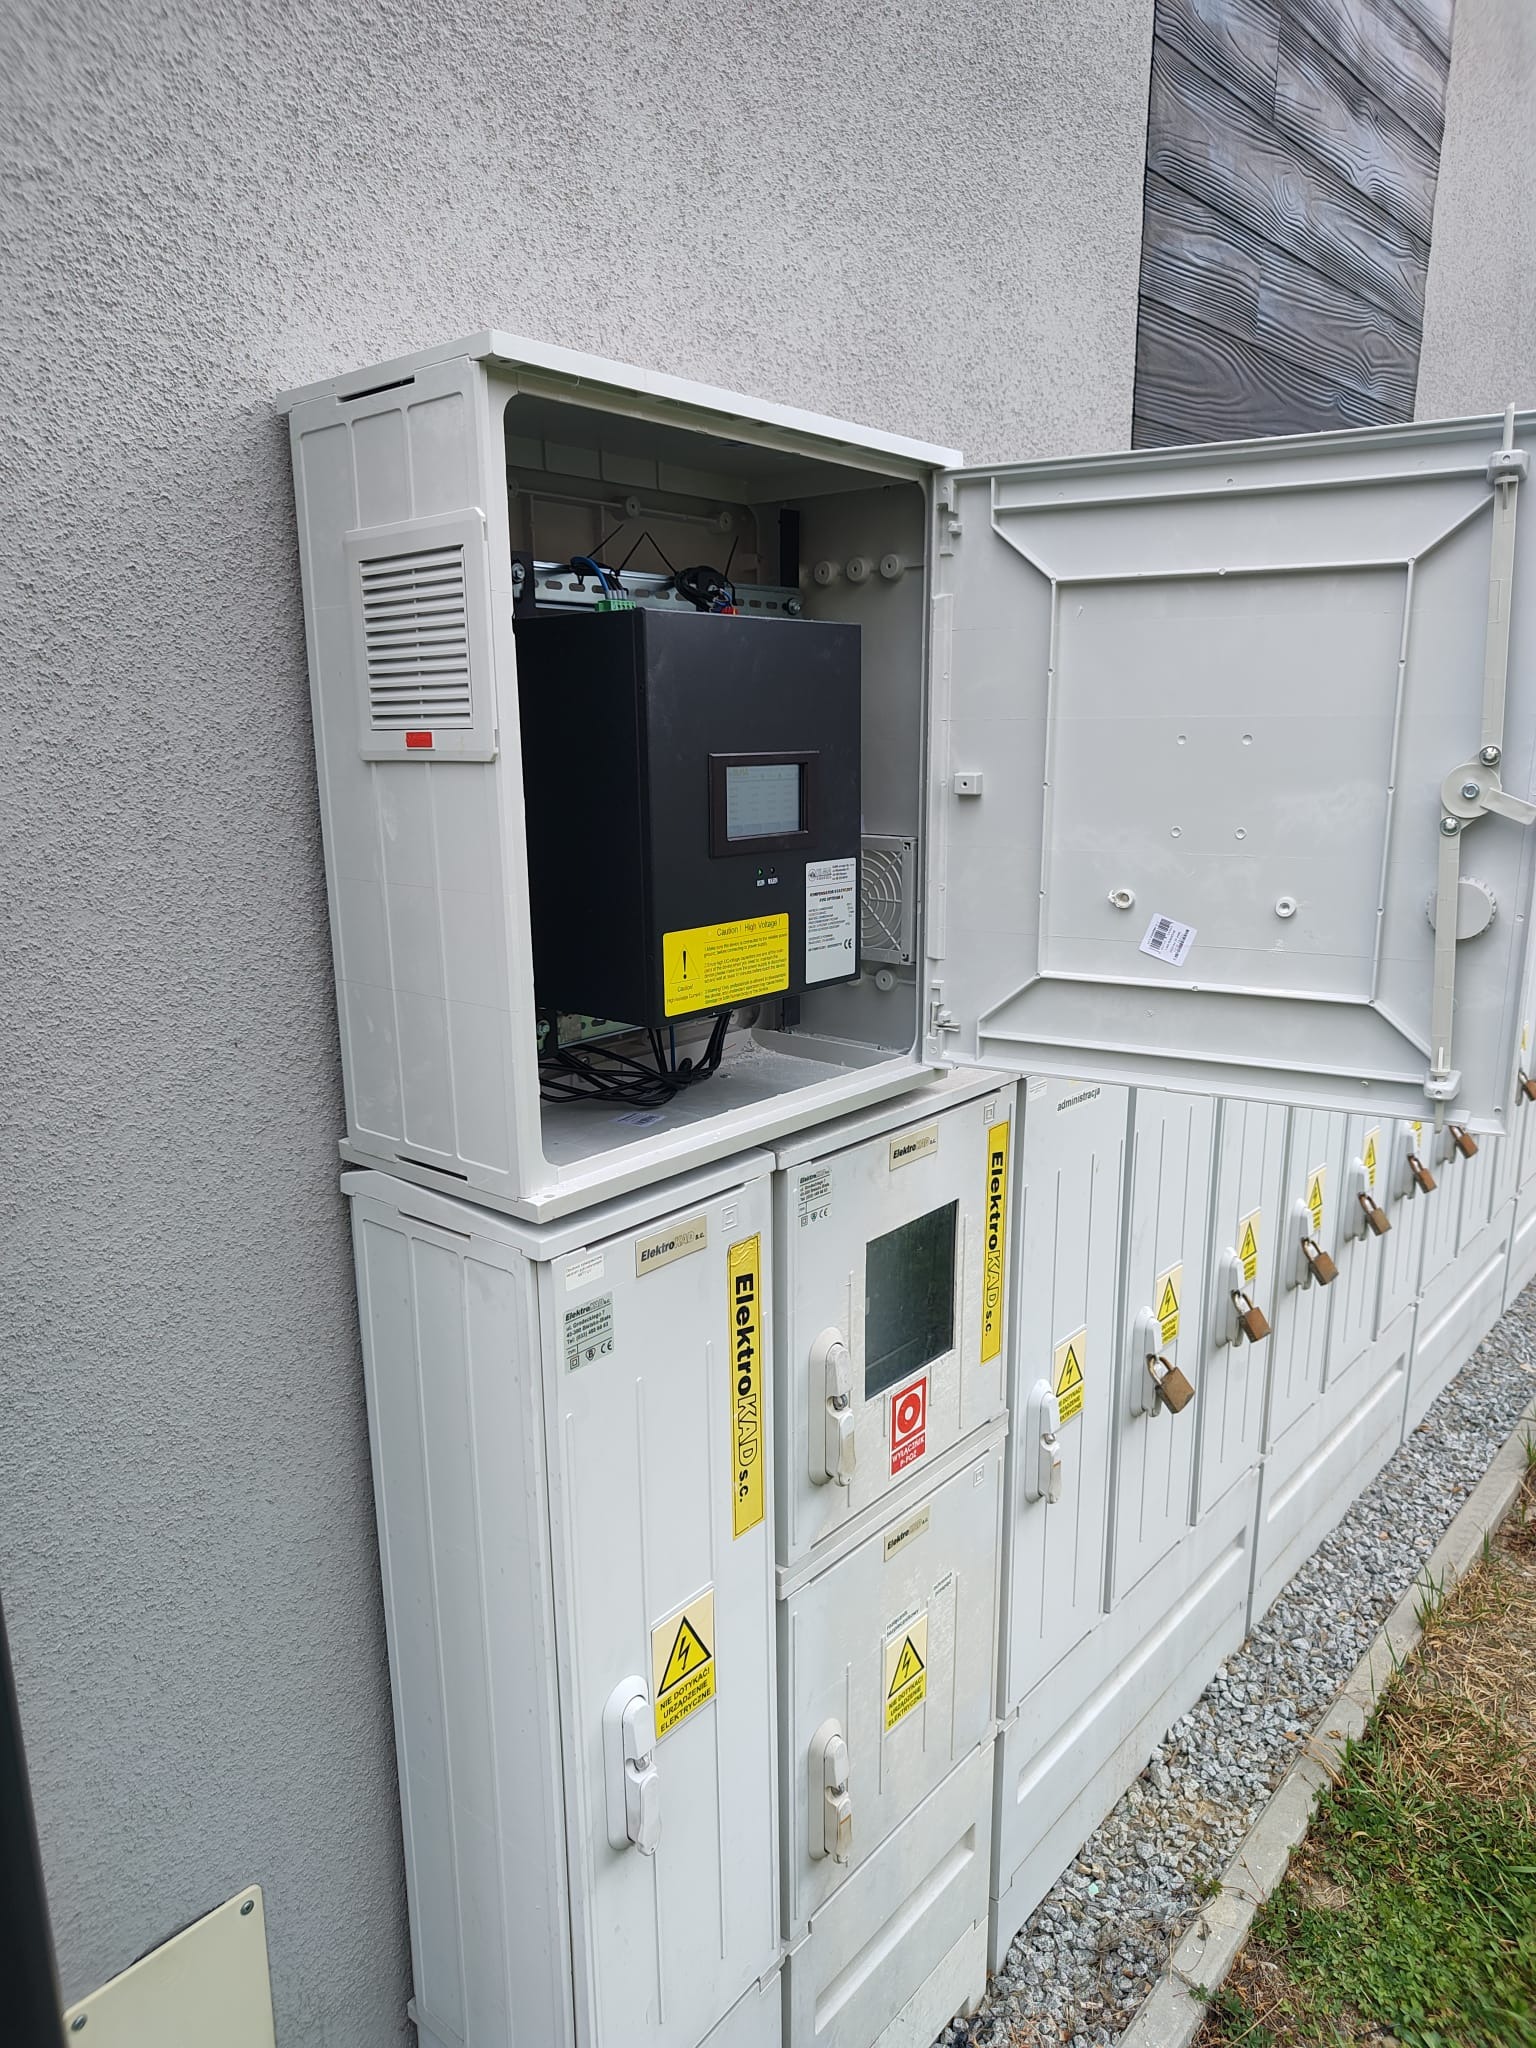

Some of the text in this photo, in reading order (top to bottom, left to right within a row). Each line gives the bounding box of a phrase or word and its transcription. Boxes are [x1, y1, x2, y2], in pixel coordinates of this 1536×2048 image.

[716, 926, 738, 936] Caution
[744, 923, 756, 932] High
[758, 920, 777, 929] Voltage
[1056, 1087, 1101, 1112] administracja
[640, 1230, 696, 1263] ElektroKAD
[985, 1151, 1004, 1308] ElektroKAD
[735, 1272, 758, 1504] ElektroKAD s.c.
[660, 1666, 710, 1712] NIE DOTYKAĆ!
[664, 1679, 708, 1718] URZĄDZENIE
[888, 1691, 924, 1726] ELEKTRYCZNE
[660, 1686, 712, 1733] ELEKTRYCZNE
